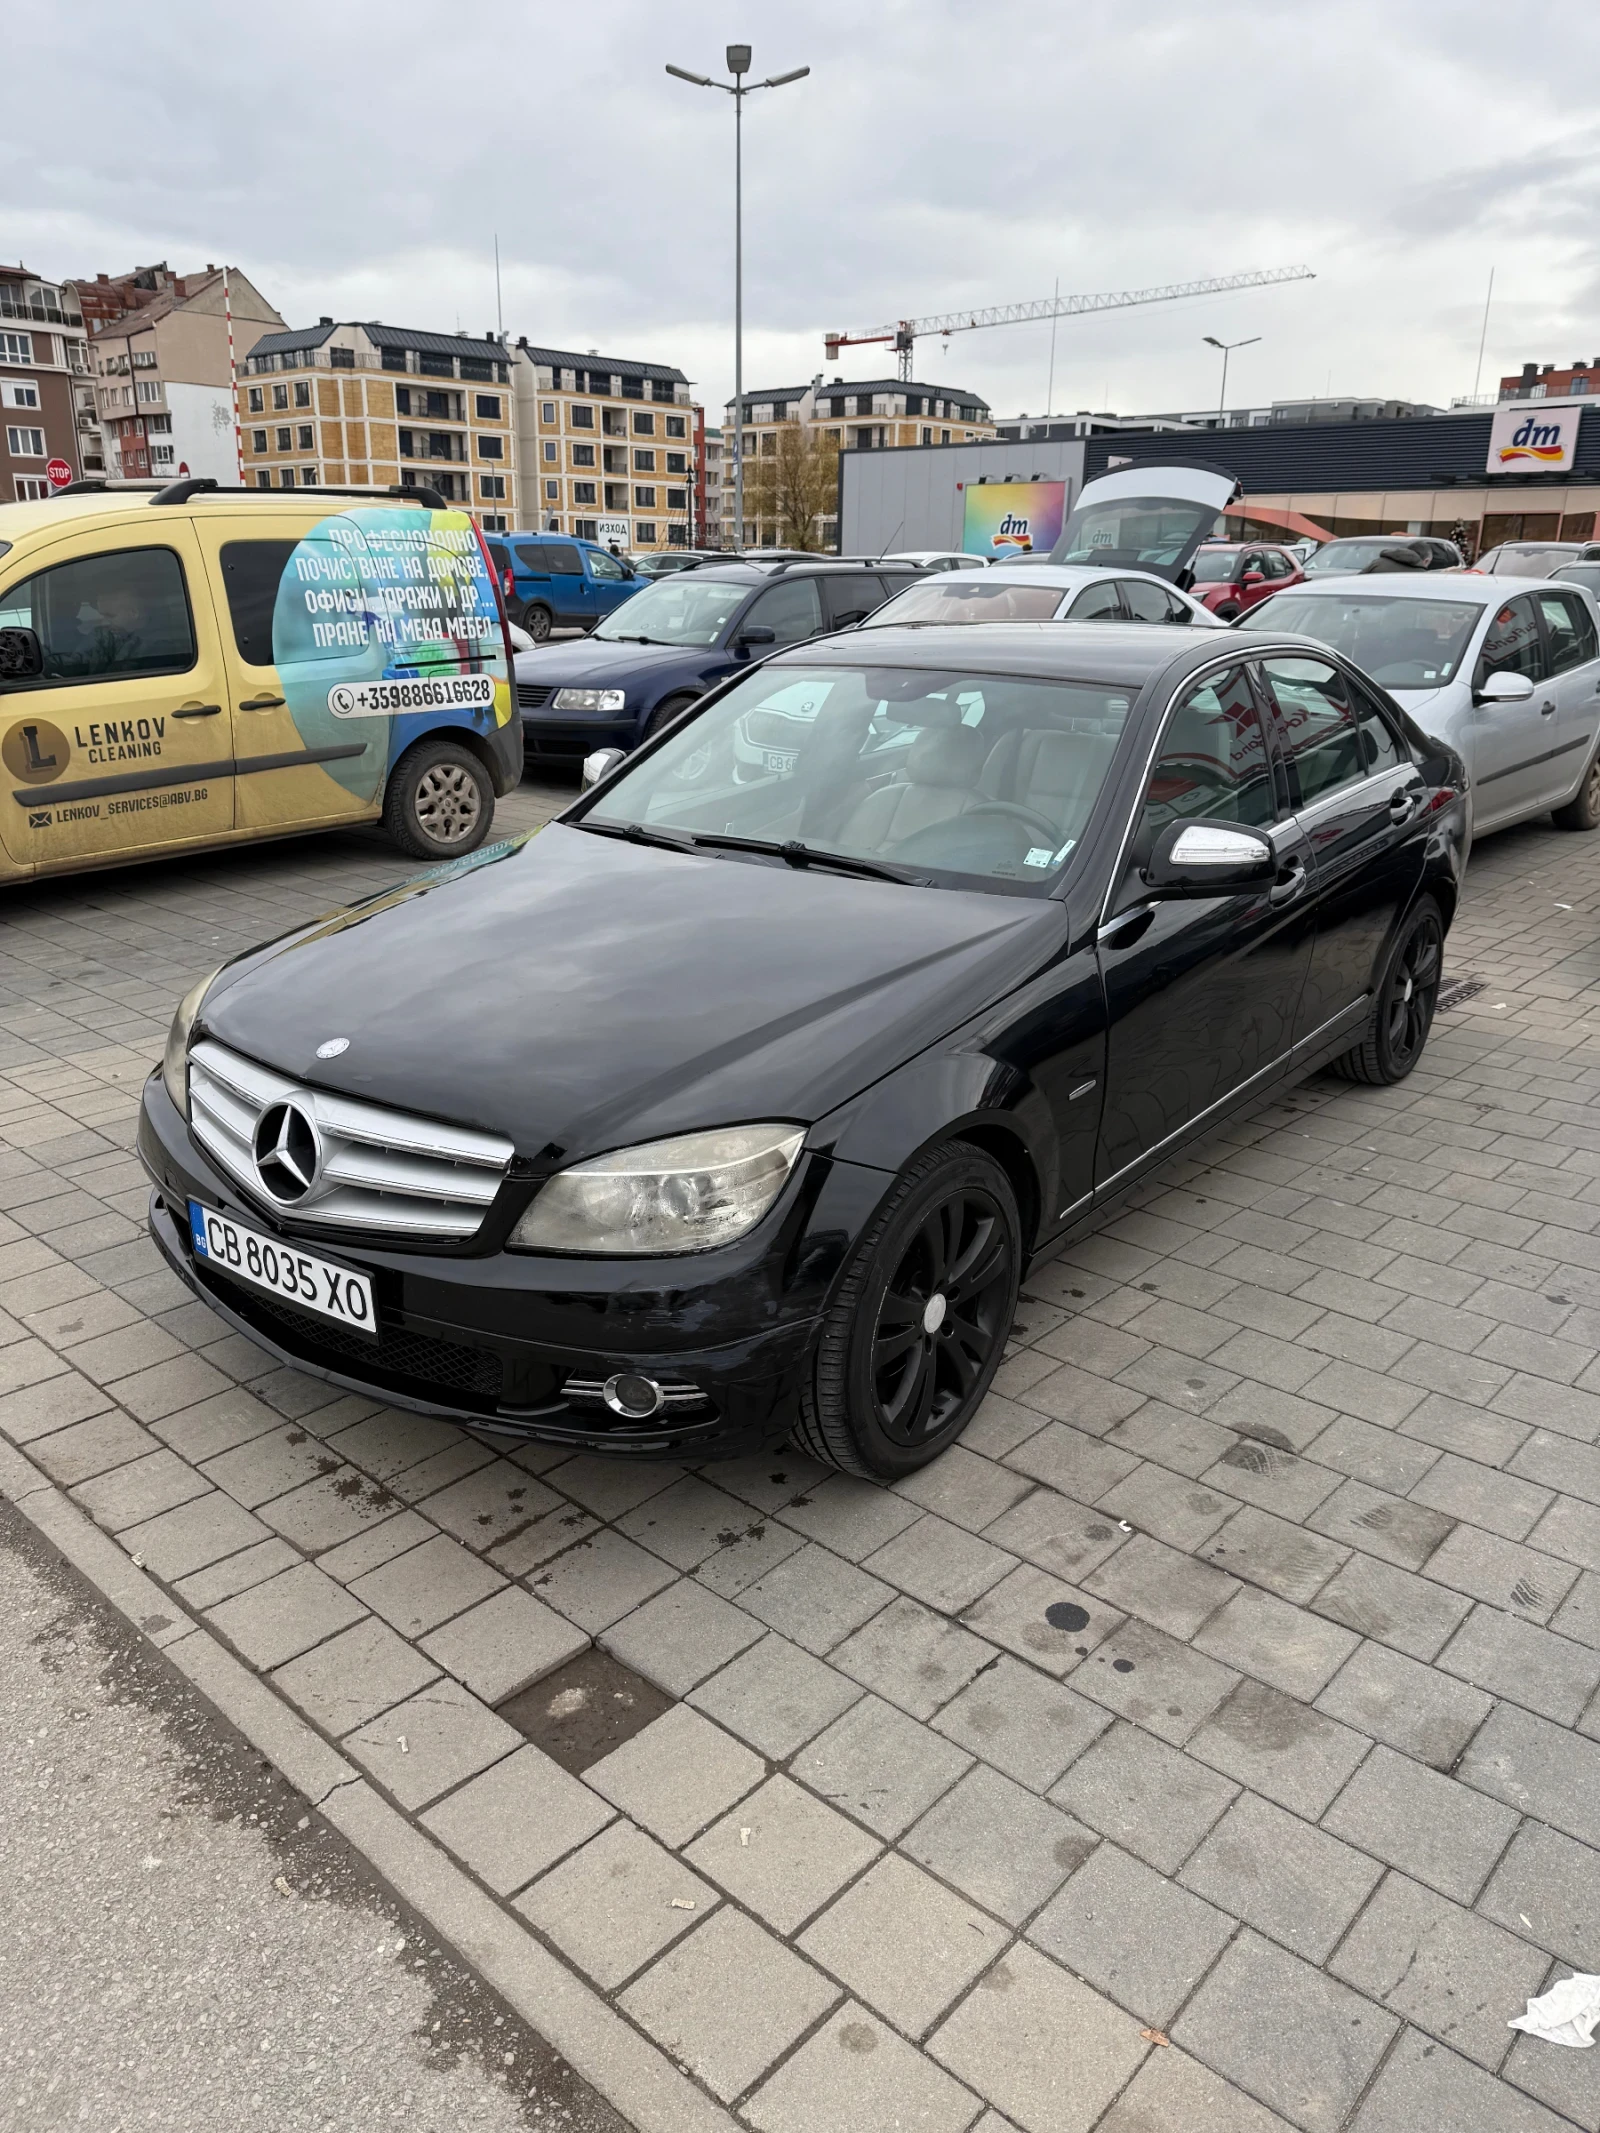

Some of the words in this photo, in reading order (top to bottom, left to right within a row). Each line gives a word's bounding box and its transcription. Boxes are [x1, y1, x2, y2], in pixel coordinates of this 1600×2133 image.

[1512, 418, 1560, 447] dm
[49, 467, 69, 479] STOP
[599, 523, 627, 535] ИЗХОД
[1000, 514, 1028, 535] dm
[1092, 528, 1112, 544] dm
[330, 529, 477, 552] ПРОФЕСИОНАЛНО
[296, 557, 399, 581] ПОЧИСТВАНЕ
[402, 557, 424, 580] НА
[428, 556, 489, 582] ДОМОВЕ,
[445, 586, 457, 608] И
[312, 622, 369, 647] ПРАНЕ
[375, 619, 397, 644] НА
[402, 618, 442, 642] МЕКА
[445, 616, 493, 640] МЕБЕЛ
[357, 679, 490, 711] +359886616628
[75, 716, 165, 748] LENKOV
[22, 725, 57, 769] L
[88, 741, 161, 764] CLEANING
[56, 788, 208, 823] LENKOV_SERVICES@ABV.BG
[195, 1233, 207, 1249] BG
[207, 1217, 241, 1267] CB
[246, 1236, 317, 1301] 8035
